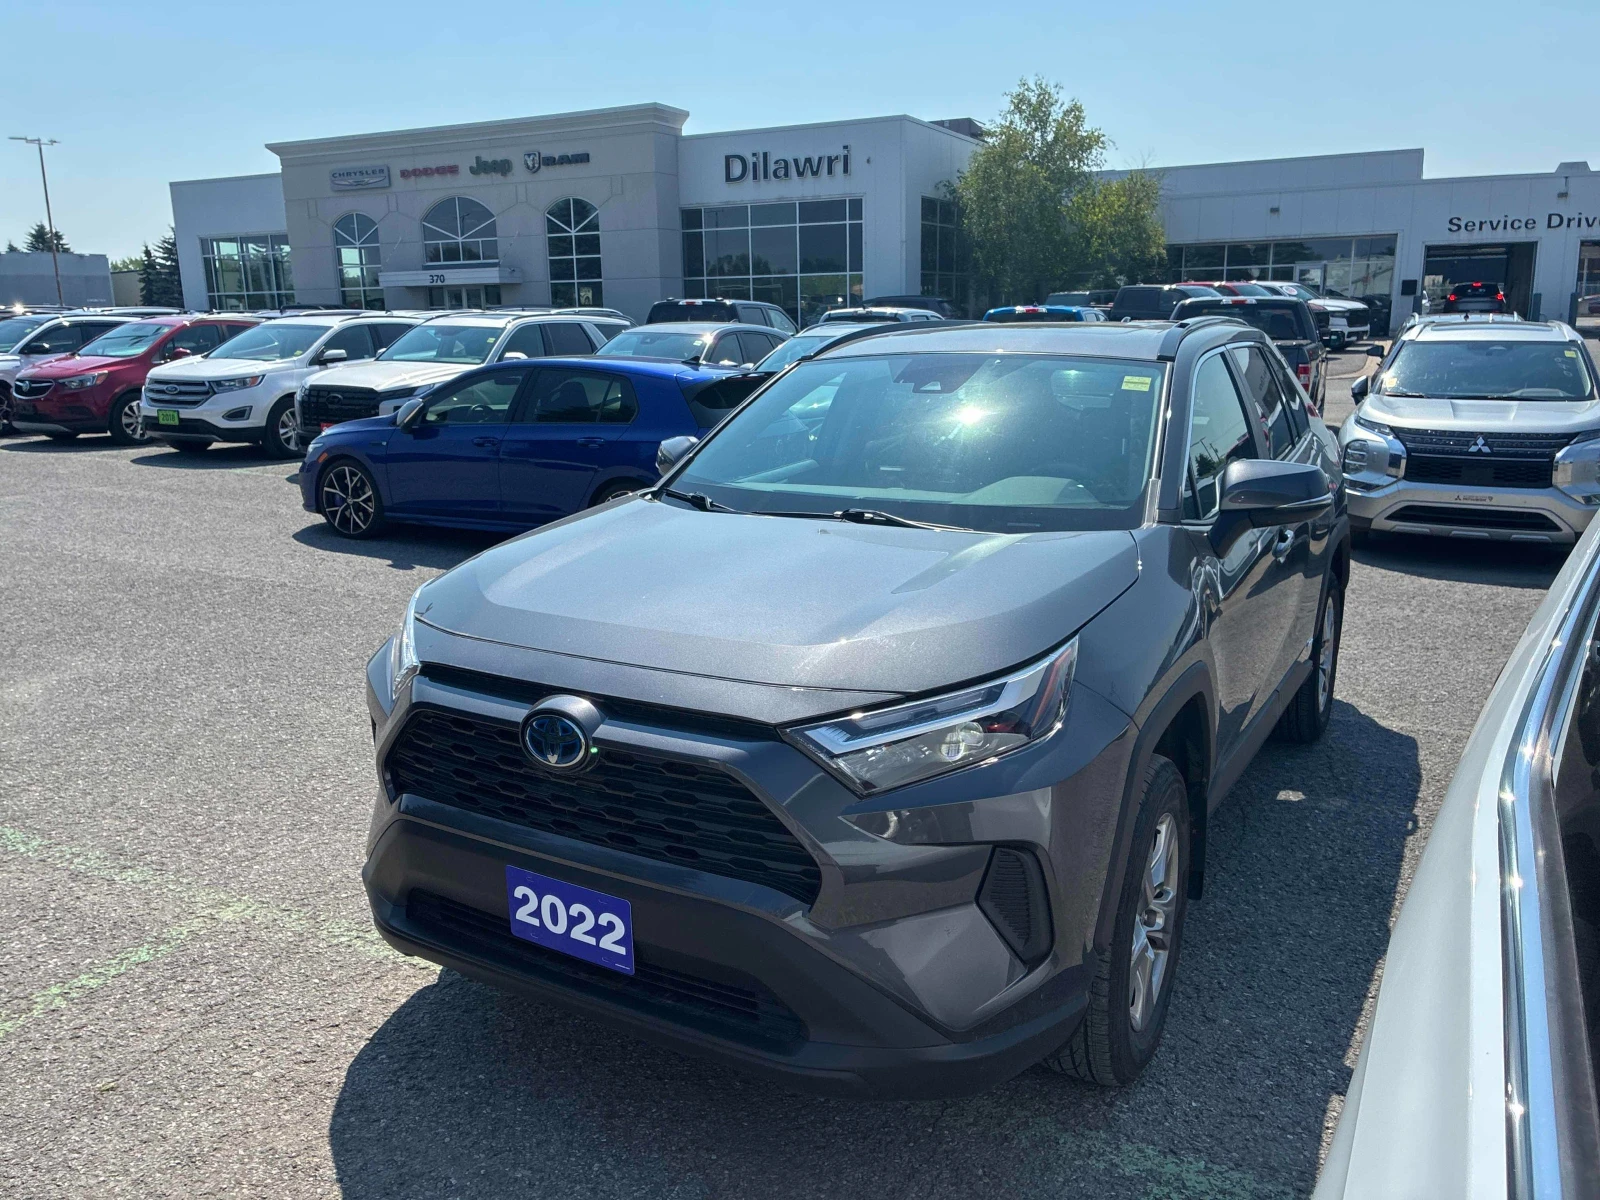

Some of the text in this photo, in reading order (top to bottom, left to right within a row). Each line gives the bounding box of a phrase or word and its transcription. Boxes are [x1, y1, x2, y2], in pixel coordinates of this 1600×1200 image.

[331, 168, 386, 179] CHRYSLER
[400, 164, 460, 180] DODGE
[469, 155, 513, 177] Jeep
[724, 145, 850, 183] Dilawri
[1447, 211, 1600, 233] Service Driv
[429, 274, 445, 284] 370
[513, 885, 627, 956] 2022
